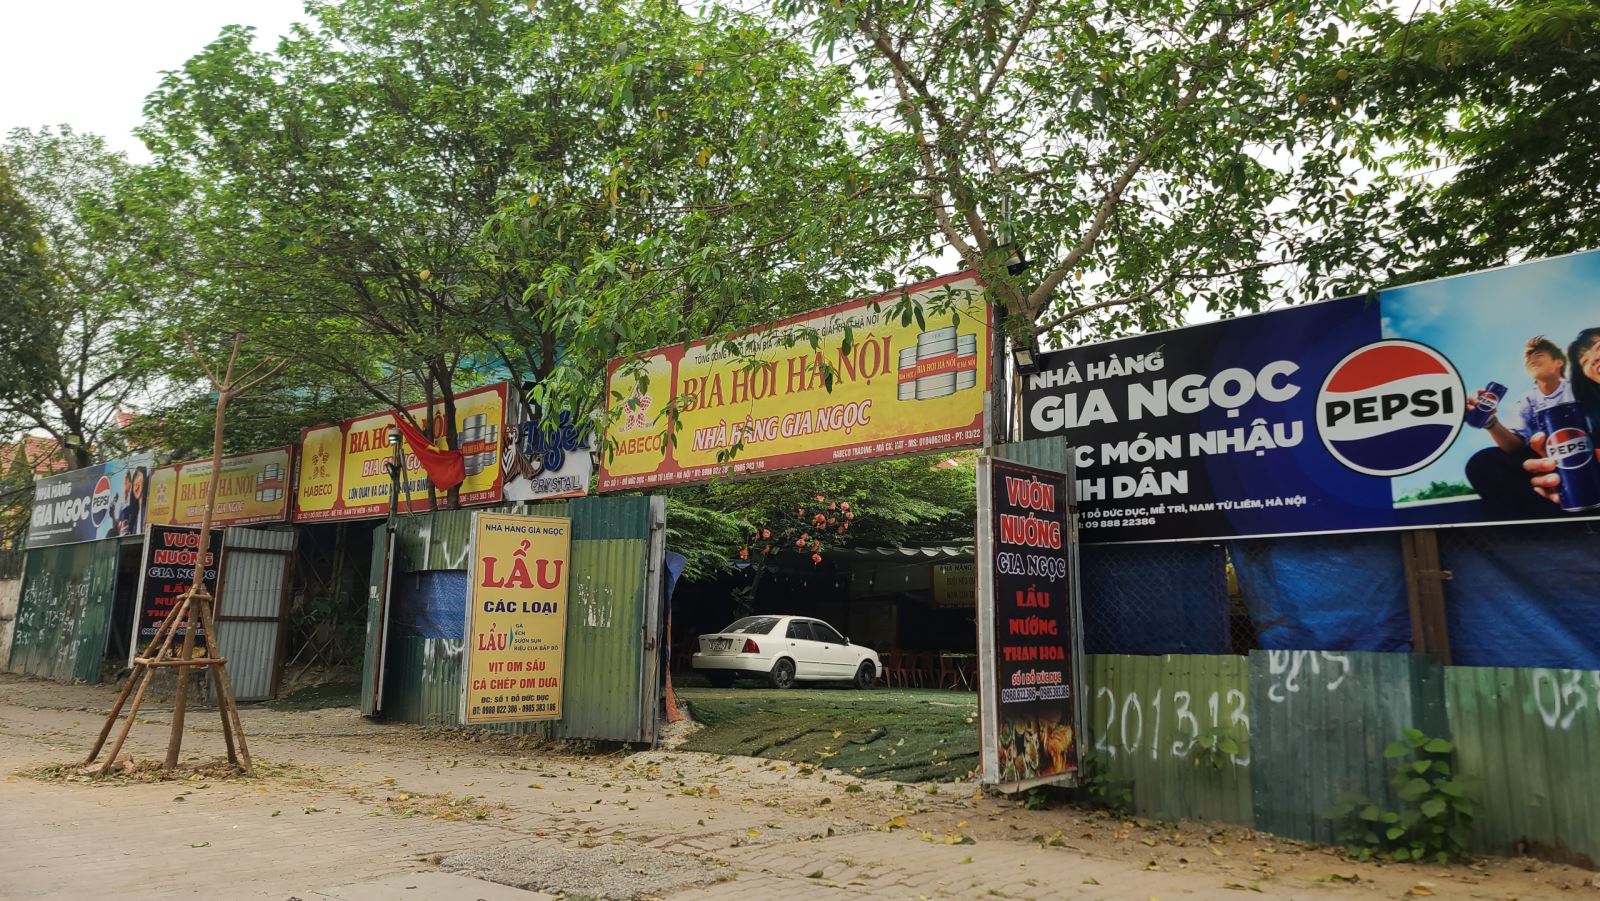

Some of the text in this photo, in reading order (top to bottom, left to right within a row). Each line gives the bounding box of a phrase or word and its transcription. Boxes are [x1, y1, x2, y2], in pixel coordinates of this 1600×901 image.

[680, 373, 725, 413] BIA
[835, 332, 893, 386] NỘI
[1029, 352, 1165, 391] NHÀ HÀNG
[1030, 360, 1302, 433] GIA NGỌC
[1325, 386, 1454, 428] PEPSI
[692, 399, 873, 452] NHÀ HÀNG GIA NGỌC
[349, 430, 371, 454] BIA
[520, 409, 594, 472] Tiger
[832, 447, 852, 459] HABECO
[852, 445, 872, 457] TRADING
[955, 431, 964, 441] PT:
[965, 429, 981, 439] 03/22
[1101, 432, 1183, 466] MÓN
[1189, 418, 1304, 457] NHẬU
[362, 459, 379, 477] BIA
[181, 483, 196, 501] BIA
[303, 484, 333, 498] HABECO
[1005, 475, 1055, 512] VƯỜN
[1113, 467, 1189, 498] DÂN
[32, 496, 91, 527] GIA NGỌC
[93, 495, 110, 507] PEPSI
[1125, 508, 1149, 517] DỤC,
[1167, 503, 1188, 514] TRÌ,
[1189, 503, 1215, 512] NAM
[1234, 499, 1264, 509] LIÊM,
[1265, 496, 1284, 507] HÀ
[1285, 495, 1307, 507] NỘI
[485, 522, 564, 537] NHÀ HÀNG GIA NGỌC
[1000, 512, 1062, 550] NƯỚNG
[1100, 519, 1121, 528] 888
[1122, 517, 1156, 527] 22386
[148, 566, 175, 579] GIA
[481, 539, 564, 589] LẨU
[997, 552, 1066, 582] GIA NGỌC
[483, 598, 558, 616] CÁC LOẠI
[1015, 584, 1050, 609] LẨU
[478, 622, 508, 651] LẨU
[1009, 615, 1058, 635] NƯỚNG
[1003, 645, 1065, 662] THAN HOA
[488, 661, 504, 675] VỊT
[507, 661, 523, 672] OM
[1012, 669, 1021, 686] SỐ
[472, 676, 558, 691] CÁ CHÉP OM DƯA
[494, 694, 504, 703] SỐ
